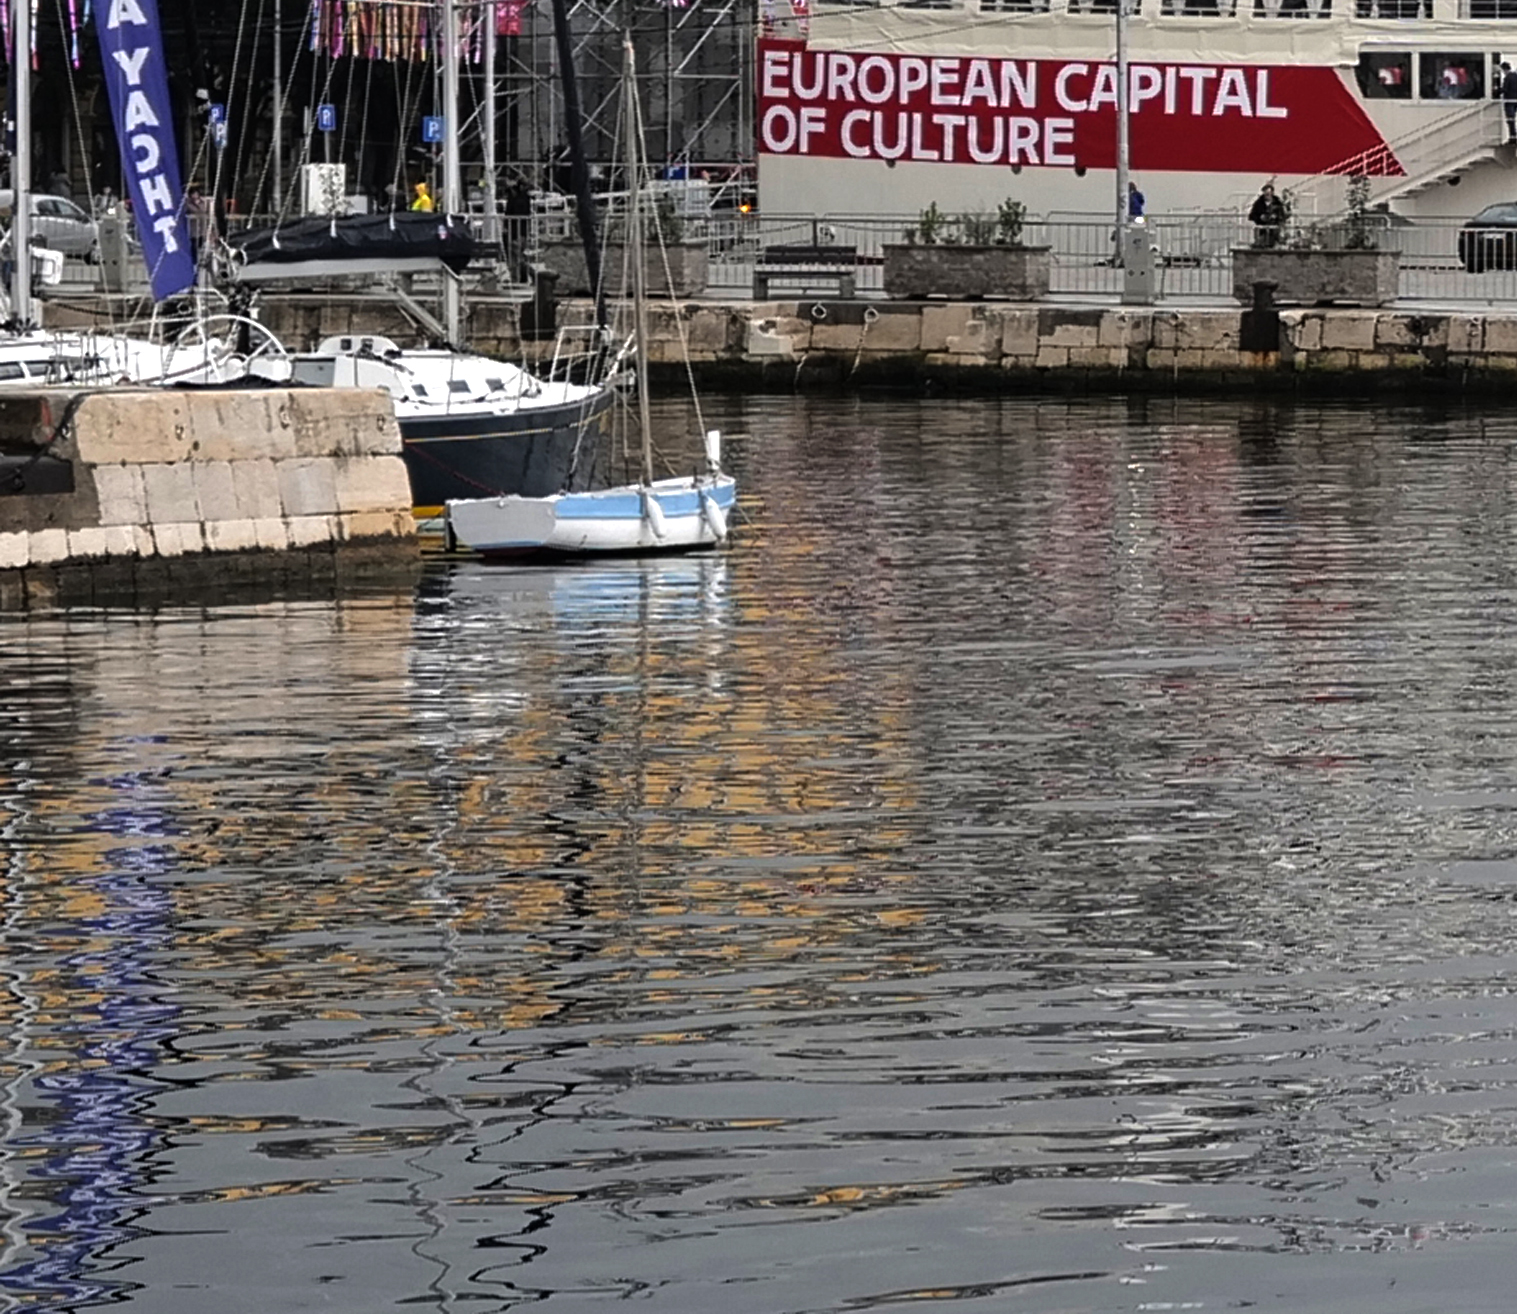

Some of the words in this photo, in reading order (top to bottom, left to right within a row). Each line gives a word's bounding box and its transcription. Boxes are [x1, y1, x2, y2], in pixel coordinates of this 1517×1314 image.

[763, 51, 1038, 108] EUROPEAN
[1055, 63, 1288, 118] CAPITAL
[762, 104, 826, 153] OF
[840, 110, 1076, 165] CULTURE
